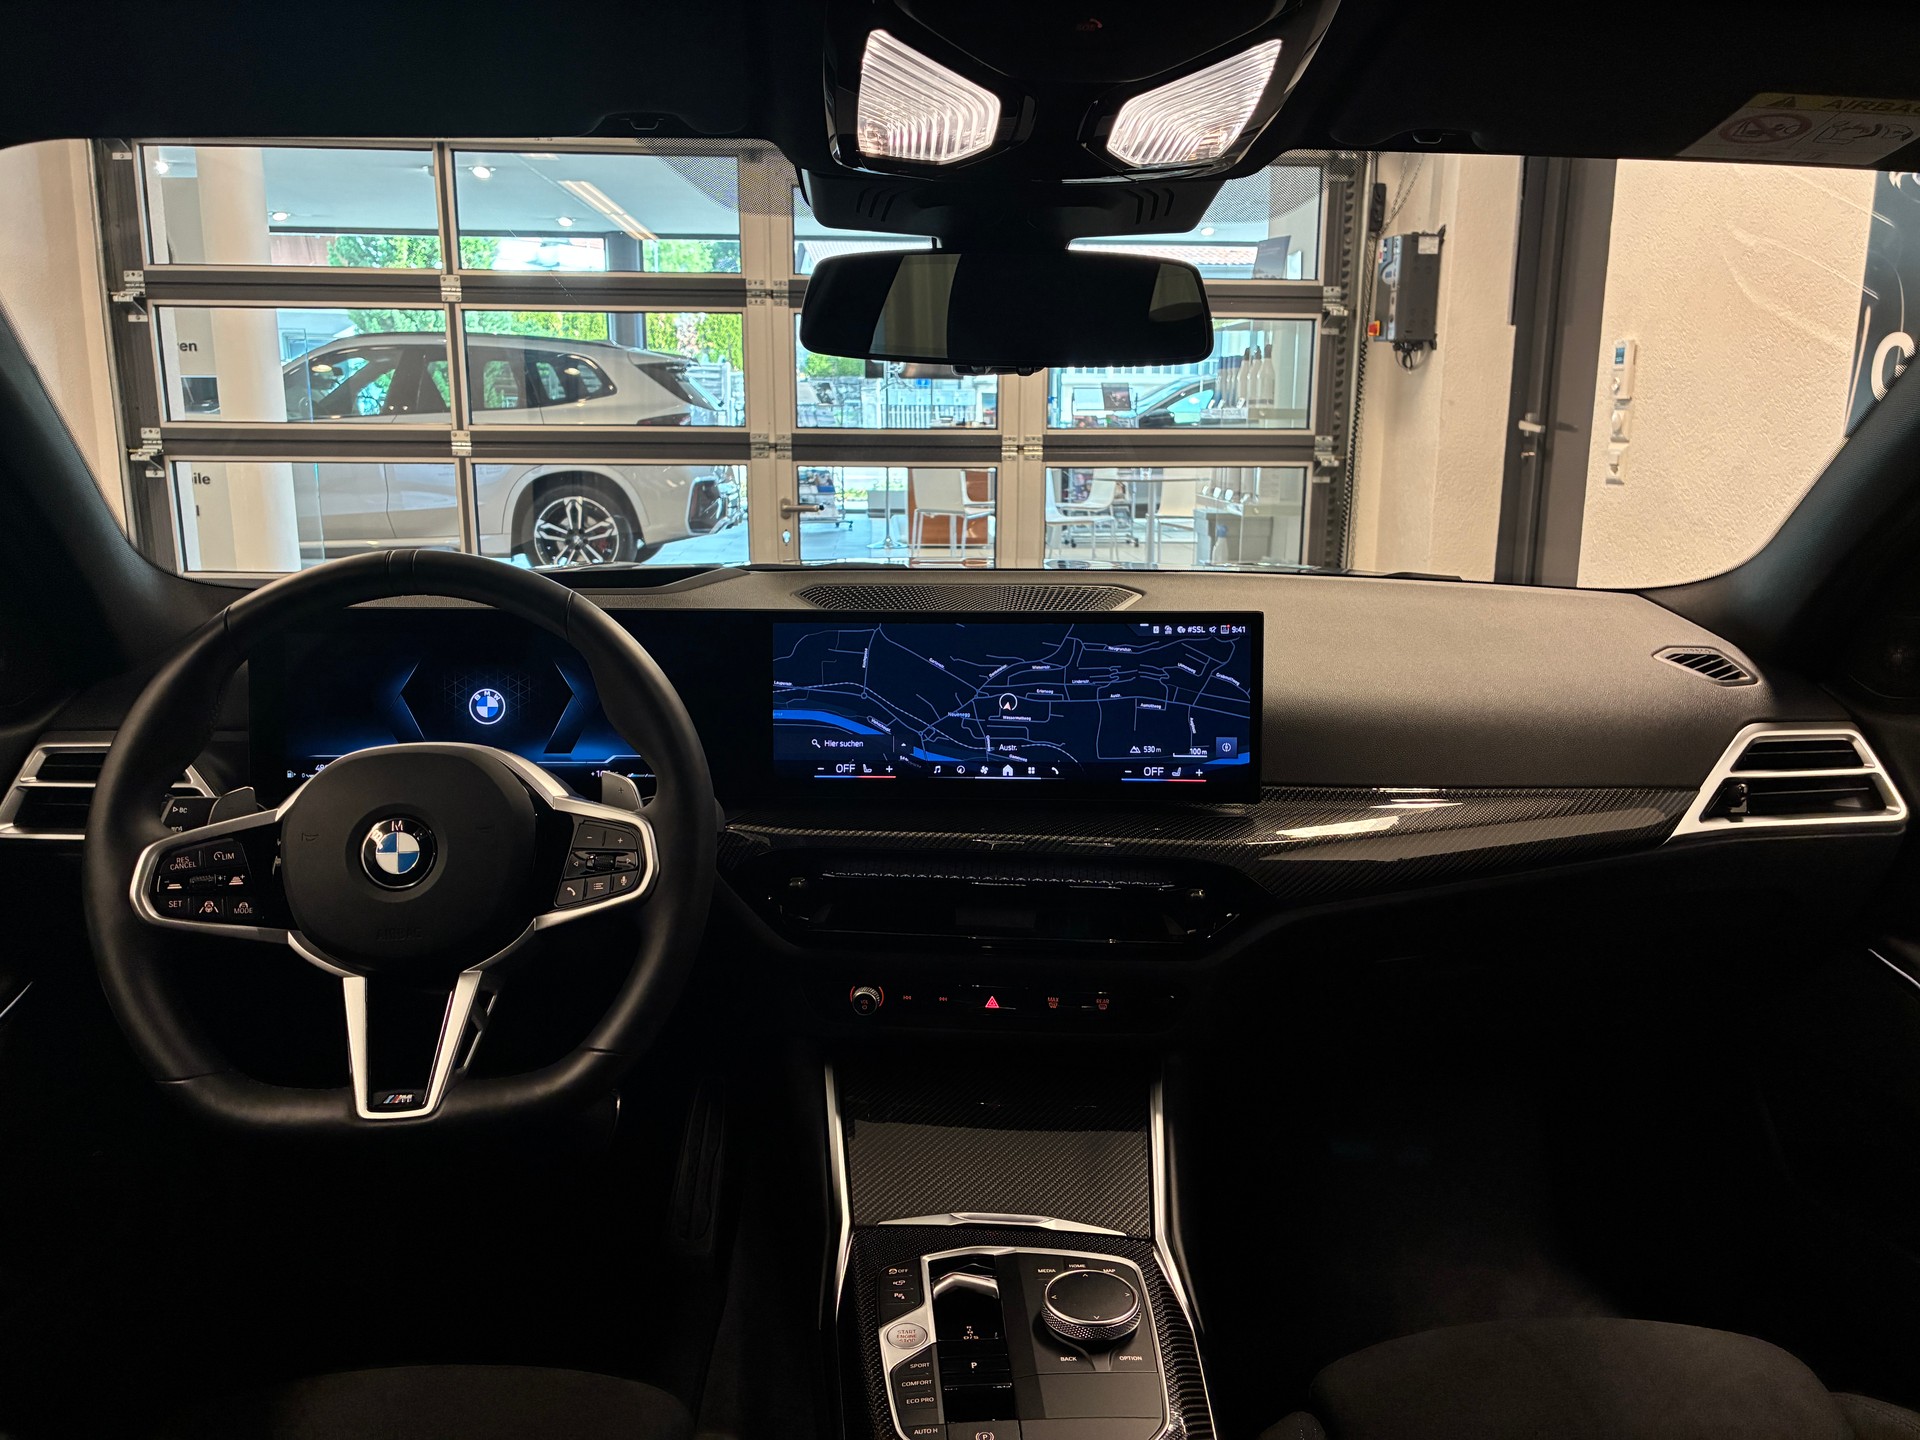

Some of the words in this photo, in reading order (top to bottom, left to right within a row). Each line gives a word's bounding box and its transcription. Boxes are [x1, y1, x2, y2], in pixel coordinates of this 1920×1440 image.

[177, 342, 198, 352] en
[192, 472, 211, 485] ile
[1231, 626, 1246, 634] 9:41
[824, 740, 839, 748] Hier
[839, 740, 864, 748] suchen
[998, 743, 1018, 751] Austr.
[1143, 745, 1155, 753] 530
[835, 763, 856, 773] OFF
[1143, 766, 1165, 776] OFF
[176, 856, 190, 864] RES
[222, 852, 235, 860] LIM
[169, 862, 197, 871] CANCEL
[970, 1361, 978, 1369] P
[901, 1379, 933, 1388] COMFORT
[906, 1397, 920, 1405] ECO
[920, 1396, 935, 1404] PRO
